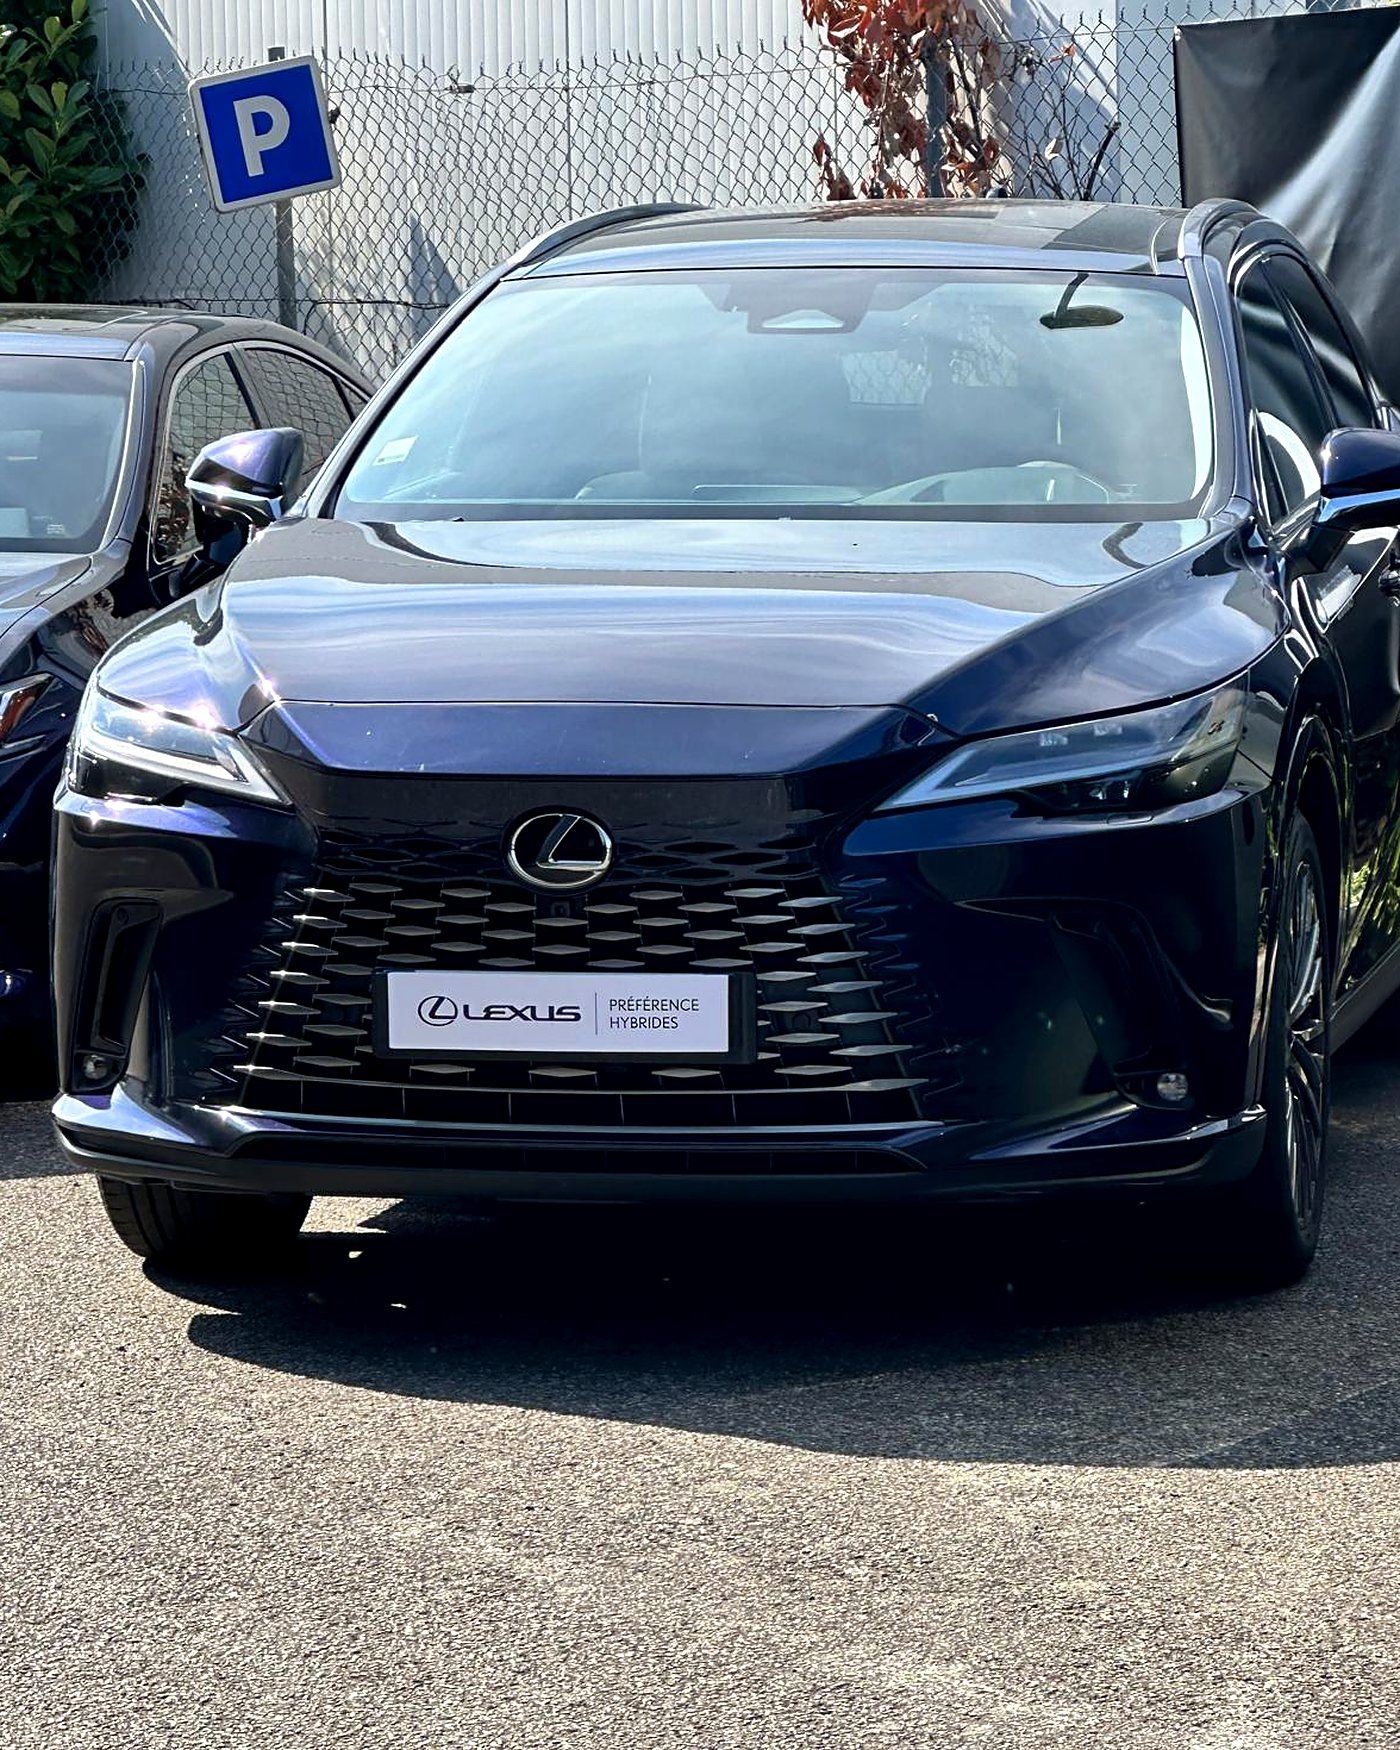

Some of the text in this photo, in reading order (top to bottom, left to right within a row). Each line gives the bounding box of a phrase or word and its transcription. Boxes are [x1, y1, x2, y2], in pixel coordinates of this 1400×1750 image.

[233, 95, 291, 177] P
[609, 995, 700, 1012] PRÉFÉRENCE
[463, 1004, 582, 1022] LEXUS
[609, 1016, 679, 1029] HYBRIDES
